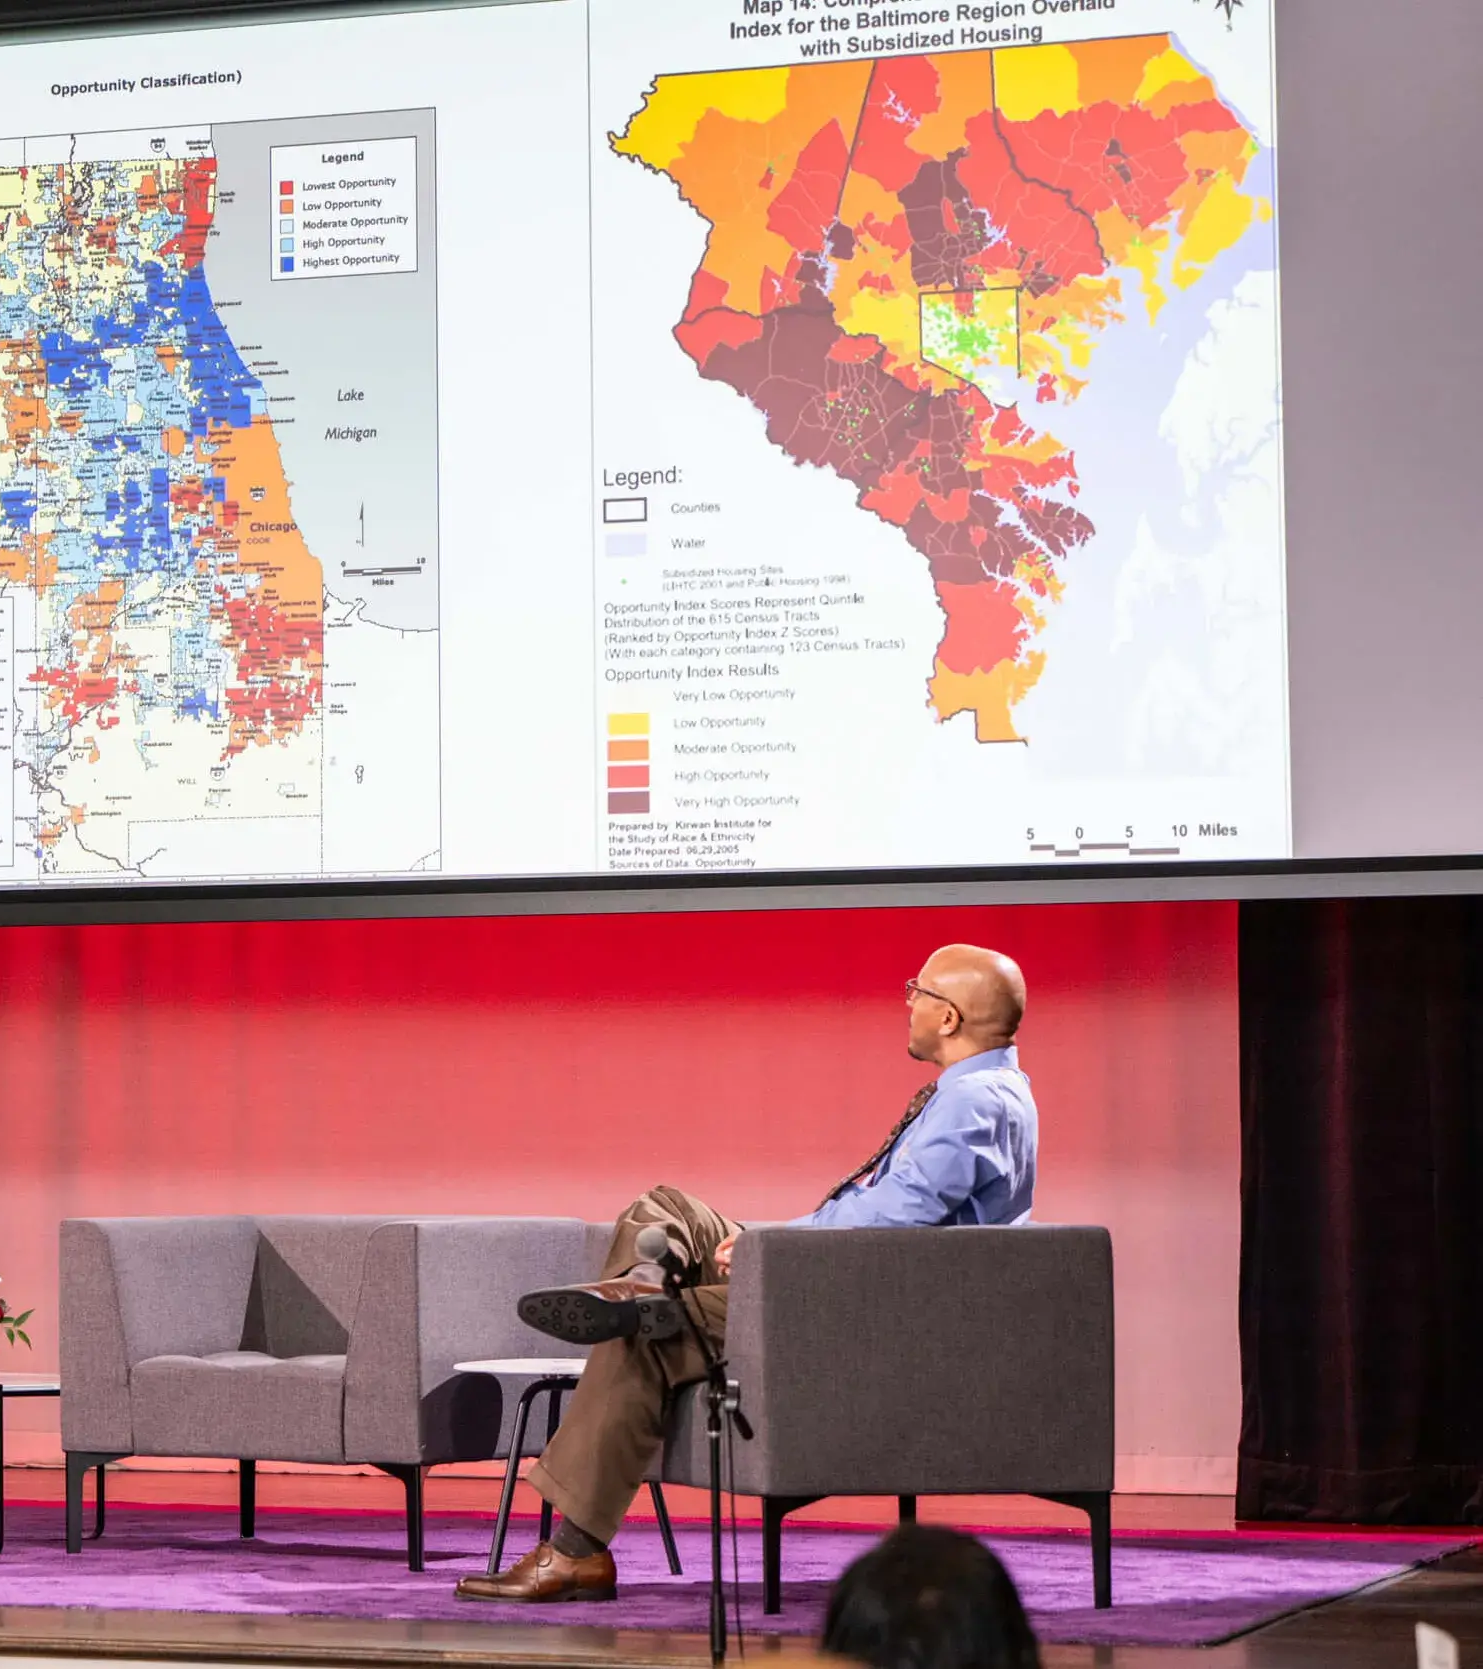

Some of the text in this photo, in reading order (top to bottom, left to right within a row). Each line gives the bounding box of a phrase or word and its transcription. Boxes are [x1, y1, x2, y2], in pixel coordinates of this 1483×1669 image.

[743, 0, 783, 16] Map
[729, 0, 1115, 40] Index for the Baltimore Region Overlaid
[799, 24, 1044, 57] with Subsidized Housing
[51, 70, 242, 97] Opportunity Classification)
[321, 151, 365, 165] Legend
[302, 177, 397, 192] Lowest Opportunity
[302, 198, 382, 212] Low Opportunity
[302, 215, 409, 230] Moderate Opportunity
[302, 236, 386, 250] High Opportunity
[302, 253, 400, 269] Highest Opportunity
[337, 388, 365, 402] Lake
[324, 427, 378, 442] Michigan
[602, 466, 683, 490] Legend:
[670, 502, 721, 515] Counties
[250, 520, 298, 536] Chicago
[670, 538, 706, 550] Water
[717, 566, 757, 578] Housing
[372, 578, 395, 587] Miles
[726, 578, 745, 589] and
[604, 592, 866, 614] Opportunity Index Scores Represent Quintile
[604, 610, 820, 628] Distribution of the 615 Census Tracts
[604, 625, 840, 646] (Ranked by Opportunity Index Z Scores)
[604, 638, 906, 661] (With each category containing 123 Census Tracts)
[604, 662, 780, 682] Opportunity Index Results
[673, 688, 796, 703] Very Low Opportunity
[673, 716, 766, 730] Low Opportunity
[674, 741, 797, 756] Moderate Opportunity
[674, 768, 770, 782] High Opportunity
[674, 794, 800, 810] Very High Opportunity
[608, 821, 654, 833] Prepared
[675, 820, 711, 830] Kirwan
[714, 818, 756, 829] Institute
[758, 818, 772, 828] for
[1026, 822, 1239, 840] 5 0 5 10 Miles
[608, 830, 756, 846] the Study of Race & Ethnicity
[608, 848, 632, 857] Date
[609, 858, 650, 870] Sources
[652, 858, 663, 868] of
[695, 856, 756, 869] Opportunity
